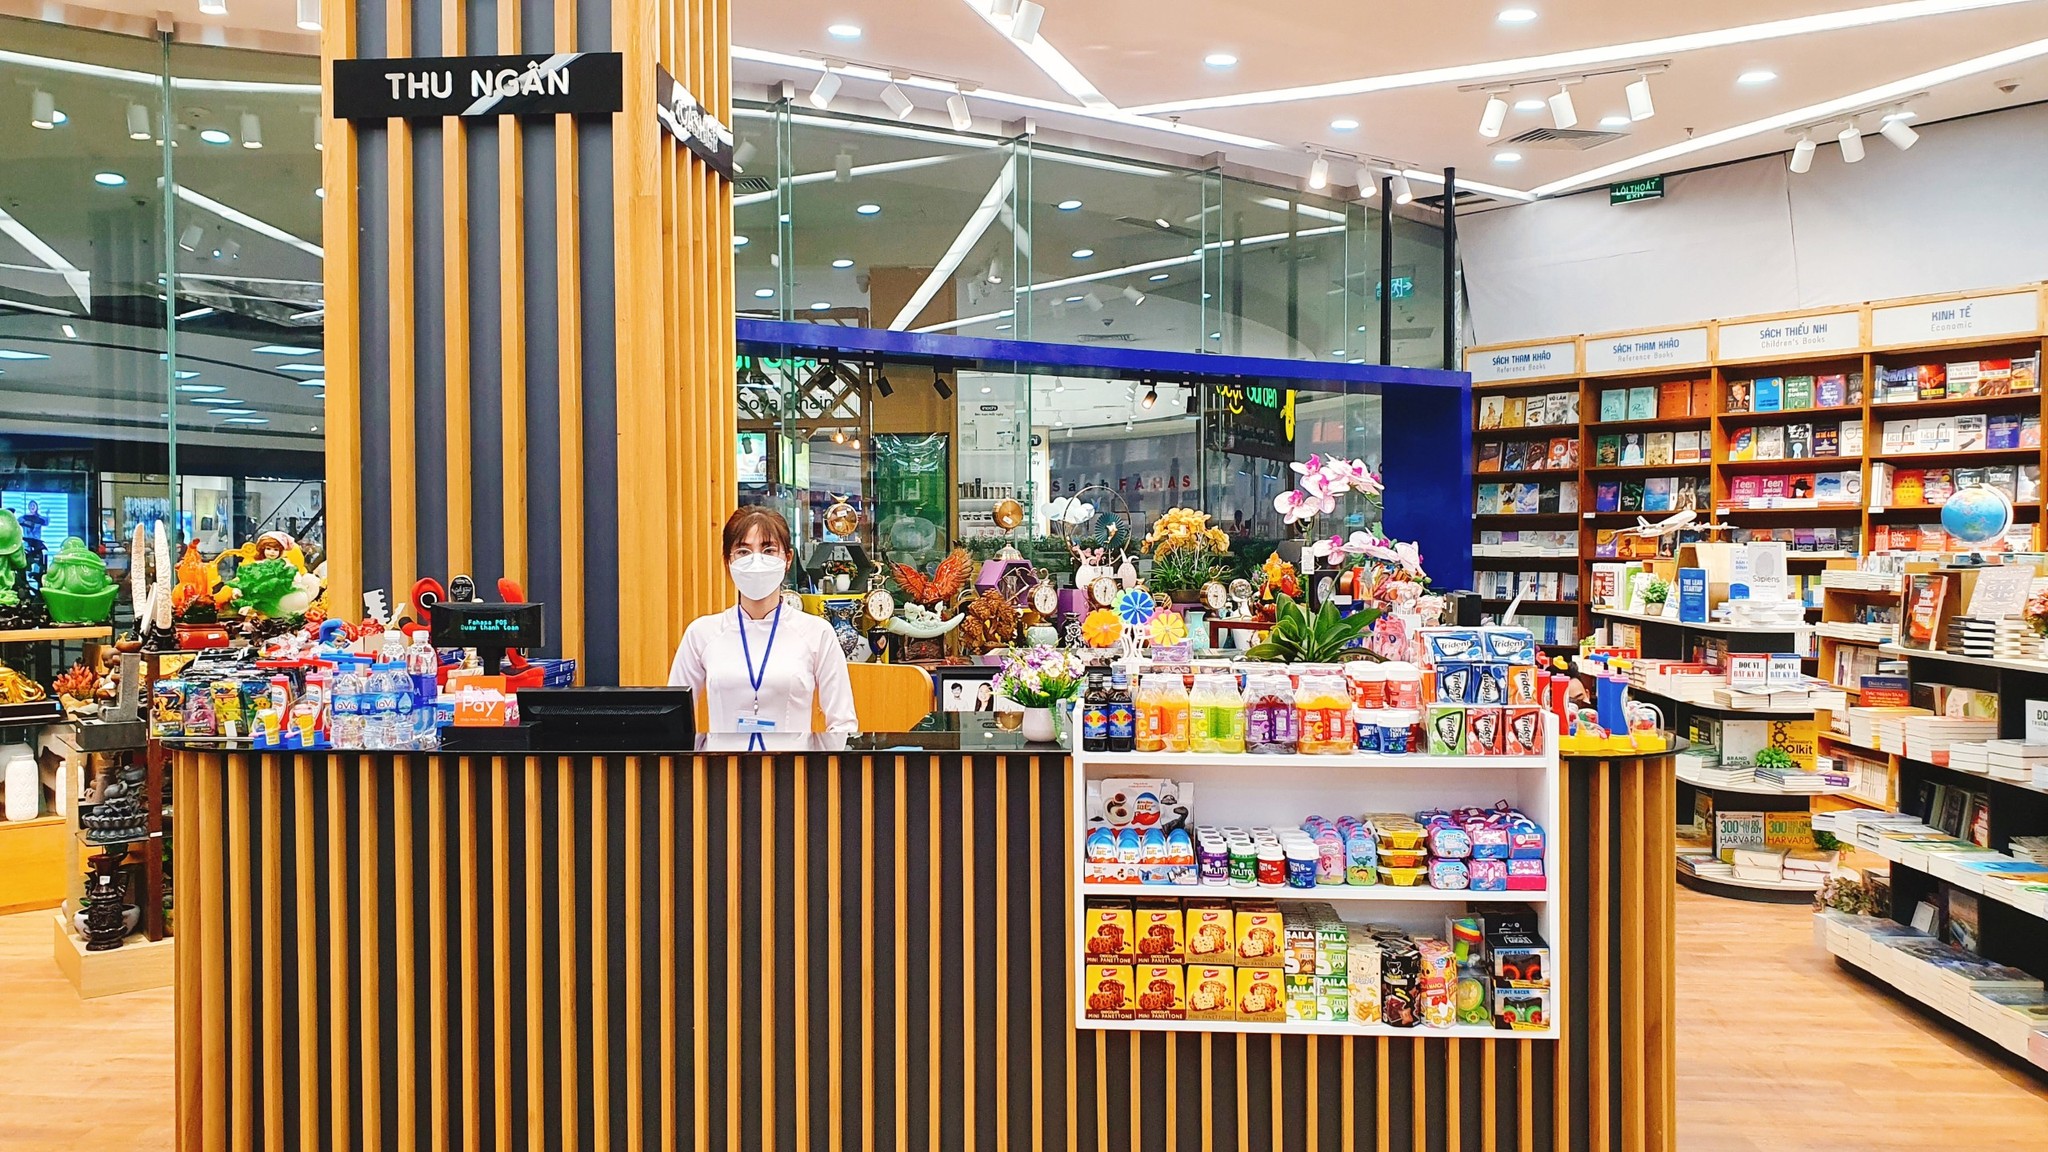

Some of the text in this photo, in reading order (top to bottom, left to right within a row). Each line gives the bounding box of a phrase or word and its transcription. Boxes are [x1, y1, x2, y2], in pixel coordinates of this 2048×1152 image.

[385, 60, 570, 99] THU NGÂN
[1931, 303, 1973, 322] KINH TẾ
[1760, 321, 1828, 339] SÁCH THIẾU NHI
[1931, 321, 1972, 332] Economic
[1613, 338, 1680, 354] SÁCH THAM KHẢO
[1761, 336, 1826, 349] Children's Books
[1492, 351, 1552, 366] SÁCH THAM KHẢO
[1618, 350, 1674, 363] Reference Books
[1496, 362, 1546, 374] Reference Books
[1735, 479, 1756, 489] Teen
[1762, 478, 1784, 488] Teen
[1692, 578, 1703, 586] LEAN
[1753, 575, 1780, 583] Sapiens
[1440, 640, 1470, 649] Trident
[1493, 640, 1523, 649] Trident
[1520, 669, 1531, 700] Trident
[462, 698, 498, 717] Pay
[1446, 716, 1456, 748] Trident
[1482, 716, 1493, 748] Trident
[1521, 716, 1533, 747] Trident
[1720, 820, 1739, 834] 300
[1768, 820, 1787, 834] 300
[1720, 835, 1763, 845] HARVARD
[1767, 836, 1812, 845] HARVARD
[1285, 931, 1314, 940] SAILA
[1318, 933, 1346, 942] SAILA
[1319, 978, 1346, 987] SAILA
[1287, 985, 1314, 993] SAILA
